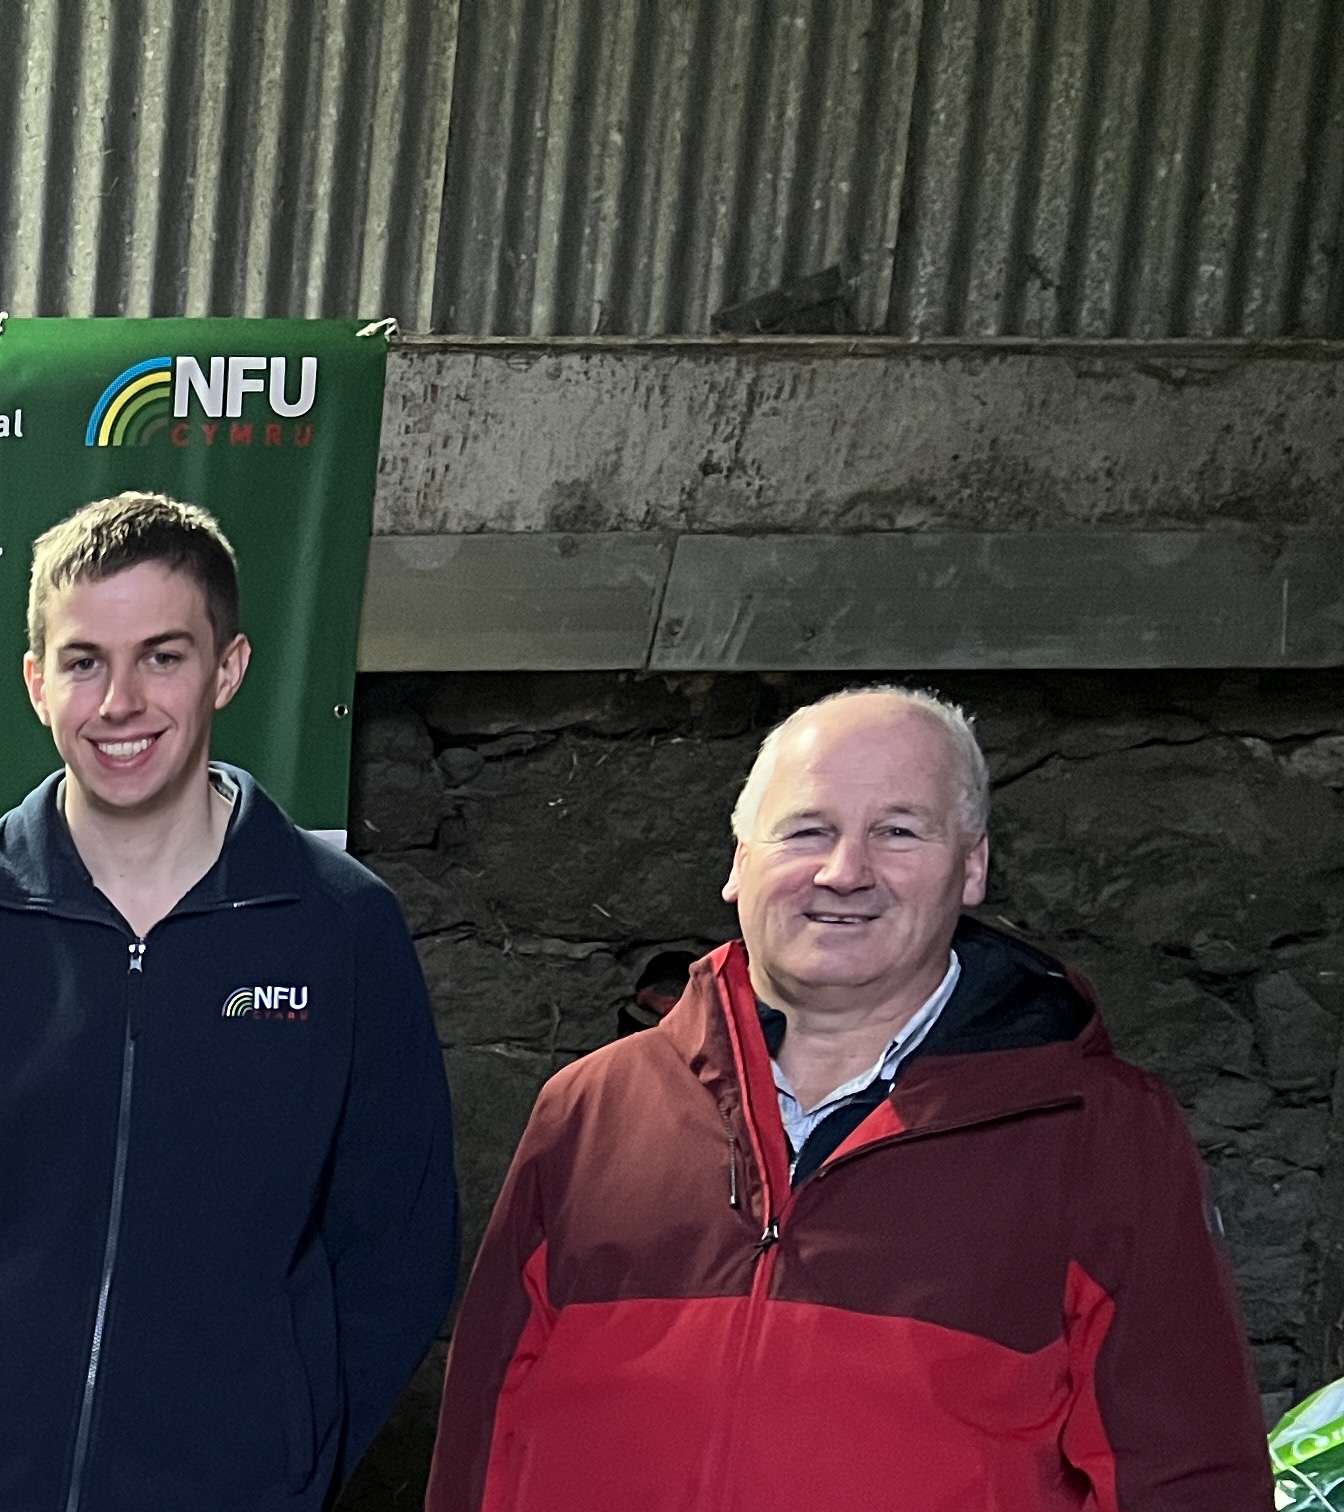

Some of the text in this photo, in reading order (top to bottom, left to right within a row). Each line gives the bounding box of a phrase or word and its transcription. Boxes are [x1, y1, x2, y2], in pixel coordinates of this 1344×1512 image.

[173, 355, 318, 418] NFU
[171, 423, 314, 447] CYMRU
[253, 985, 308, 1010] NFU
